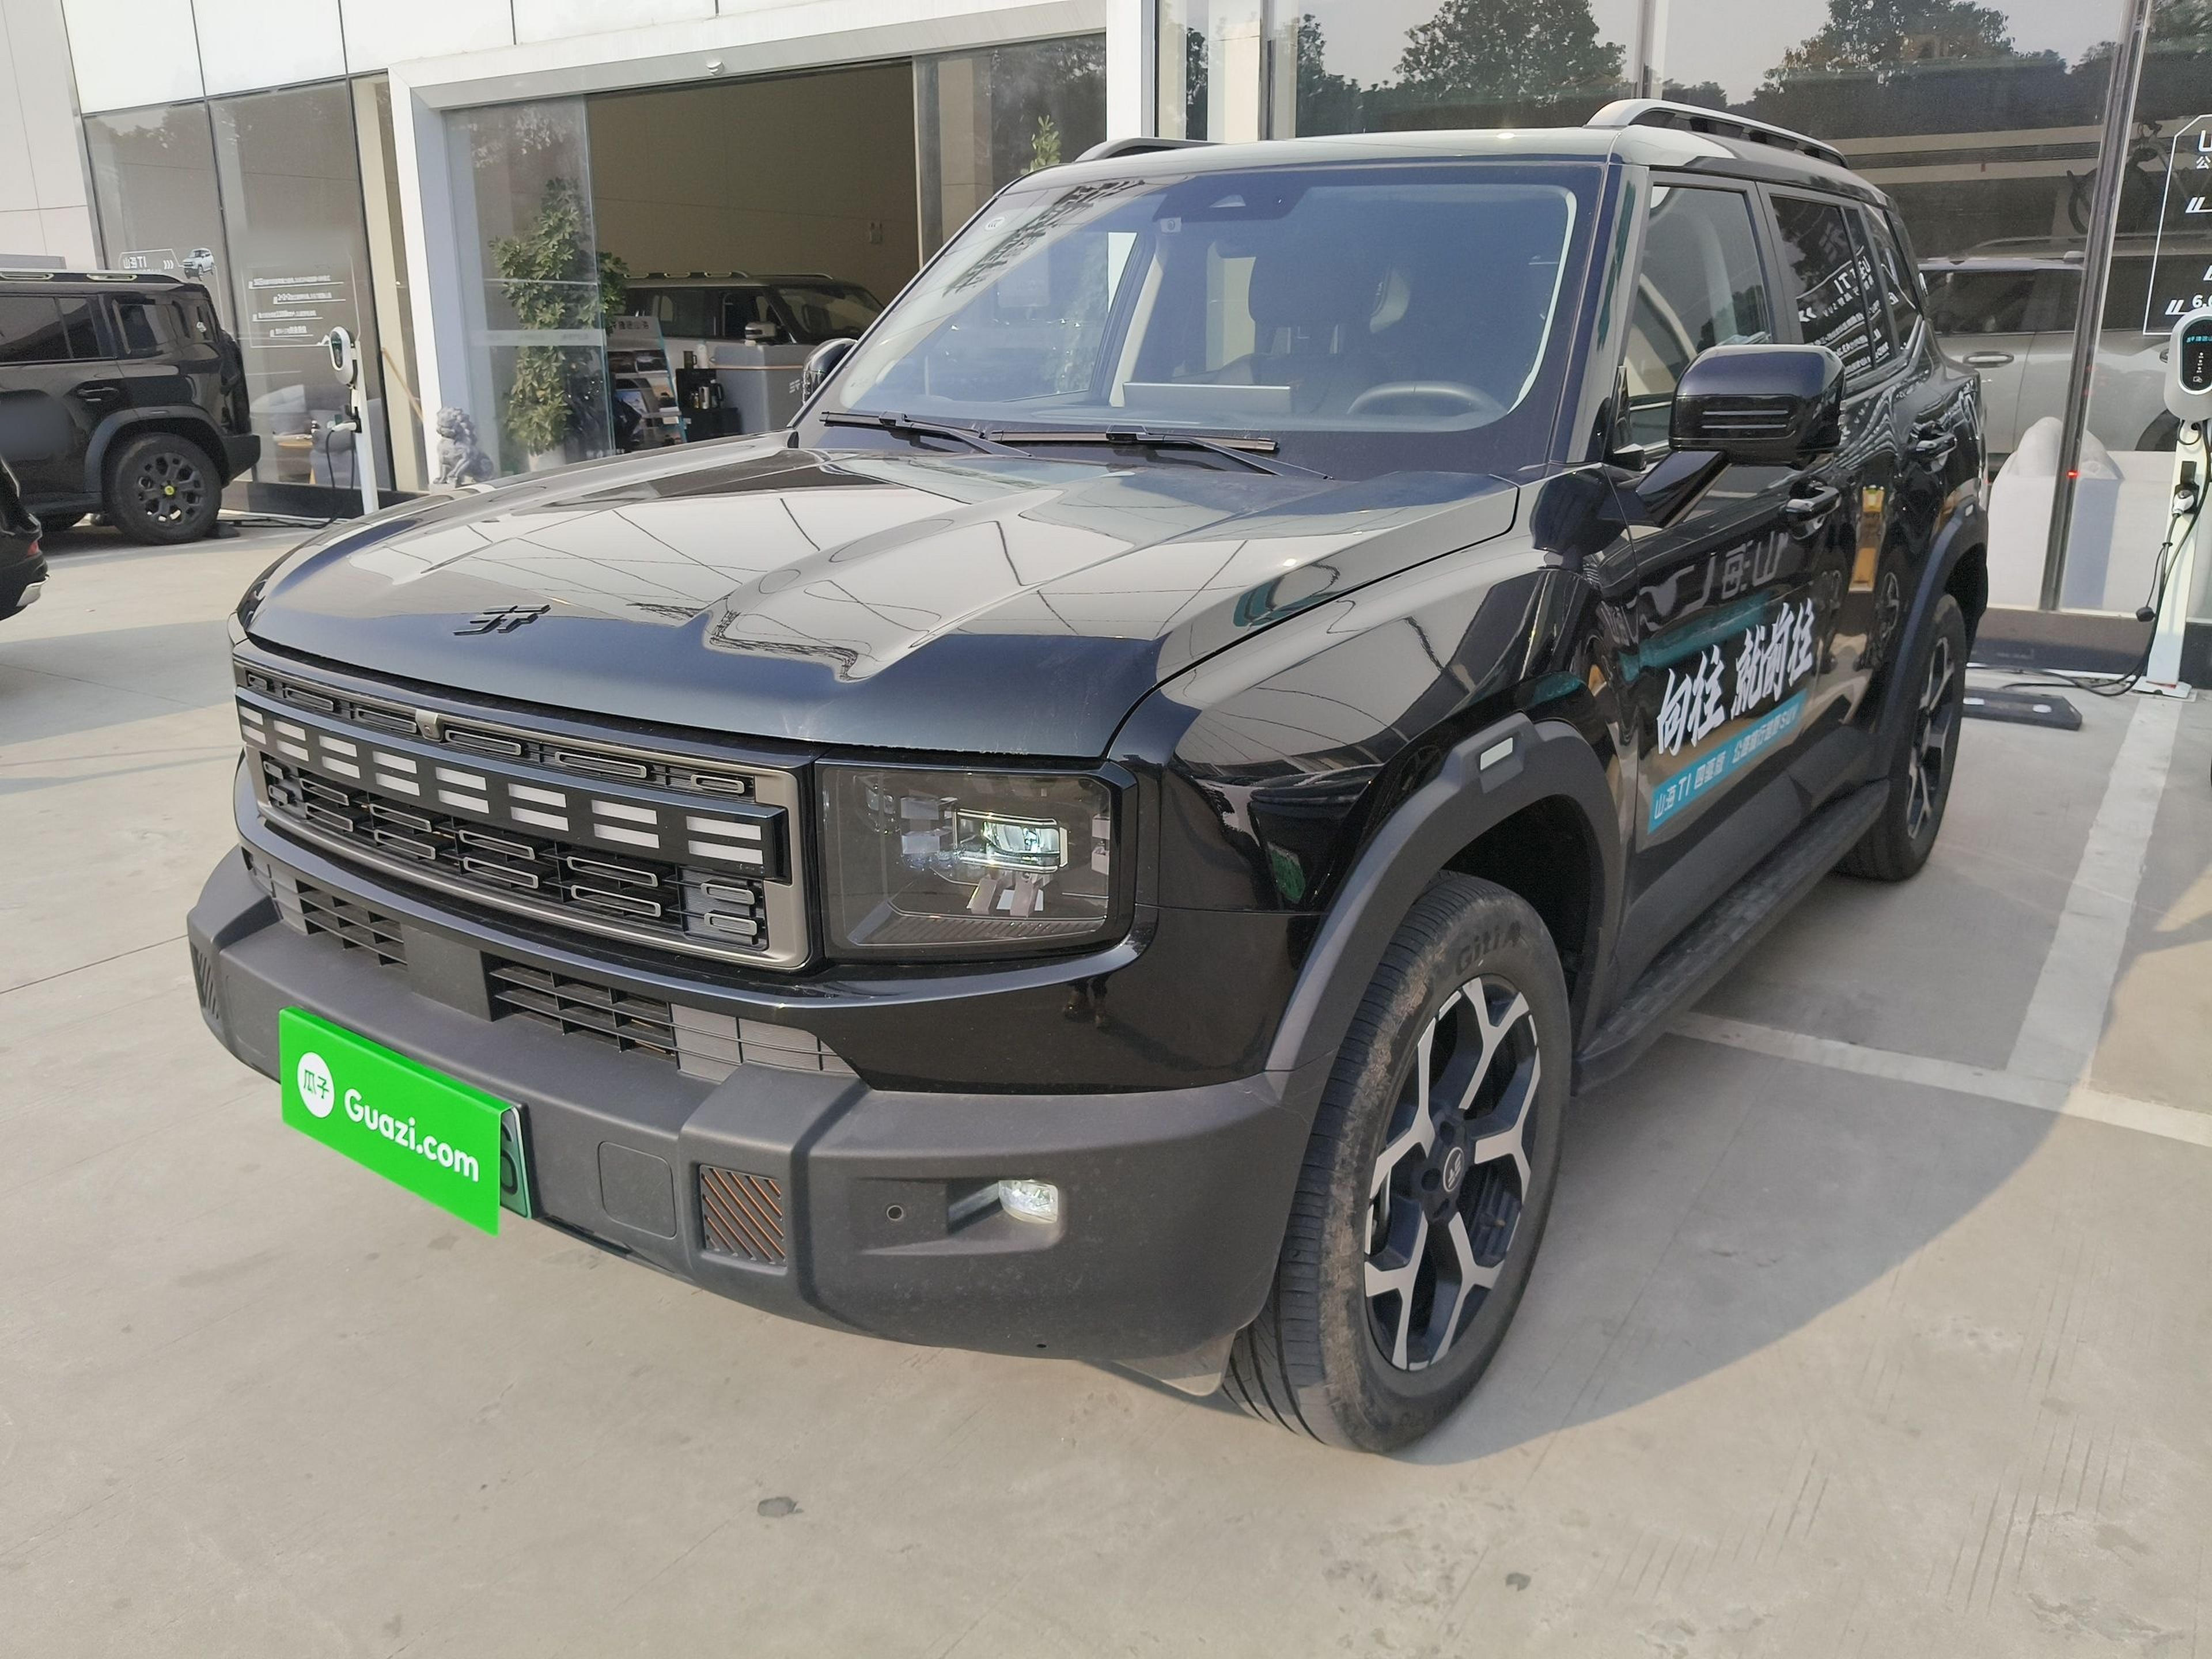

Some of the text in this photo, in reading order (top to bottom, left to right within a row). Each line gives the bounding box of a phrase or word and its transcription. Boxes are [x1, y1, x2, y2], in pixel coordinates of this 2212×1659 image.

[1657, 645, 1726, 756] 向往
[303, 1069, 329, 1100] 瓜子
[343, 1088, 479, 1183] Guazi.com
